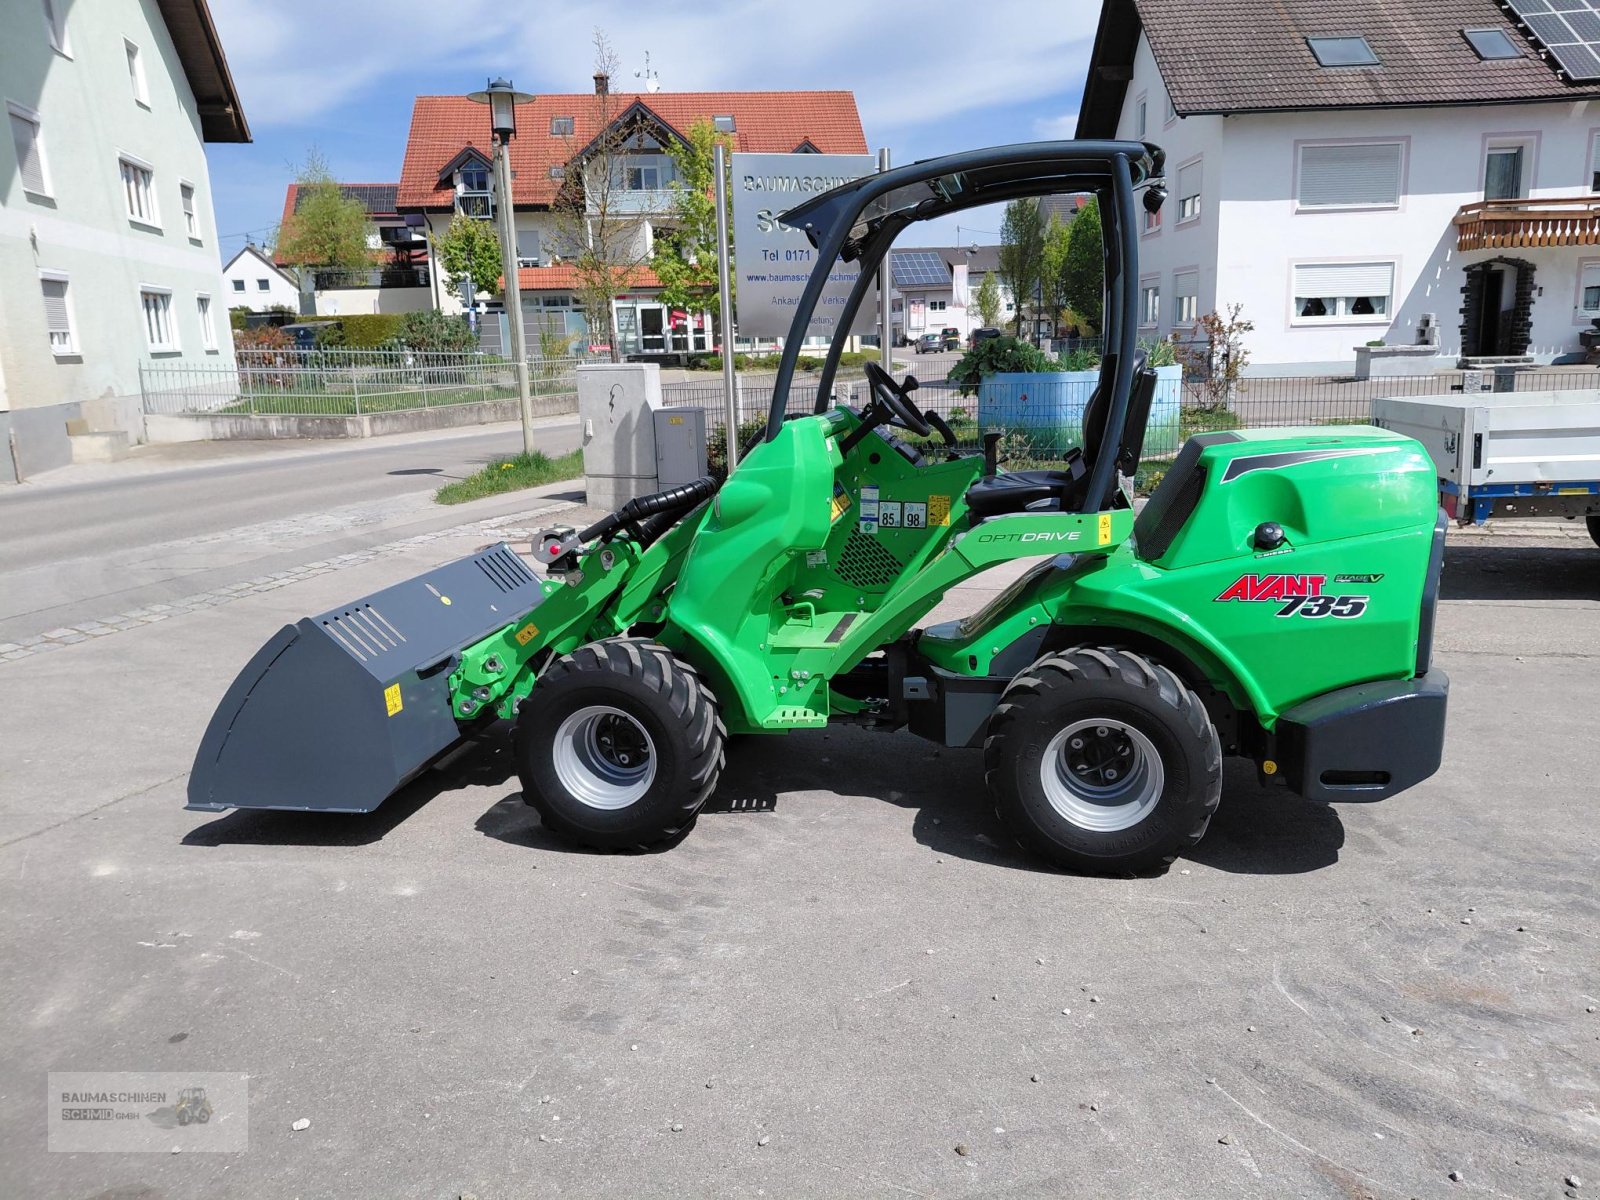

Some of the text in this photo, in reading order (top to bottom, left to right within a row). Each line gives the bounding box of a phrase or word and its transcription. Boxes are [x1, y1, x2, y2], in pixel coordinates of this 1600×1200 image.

[762, 249, 811, 261] Tel 0171
[882, 512, 920, 527] 85 98
[978, 531, 1082, 543] OPTIDRIVE
[1212, 573, 1328, 603] AVANT
[1274, 594, 1371, 619] 735
